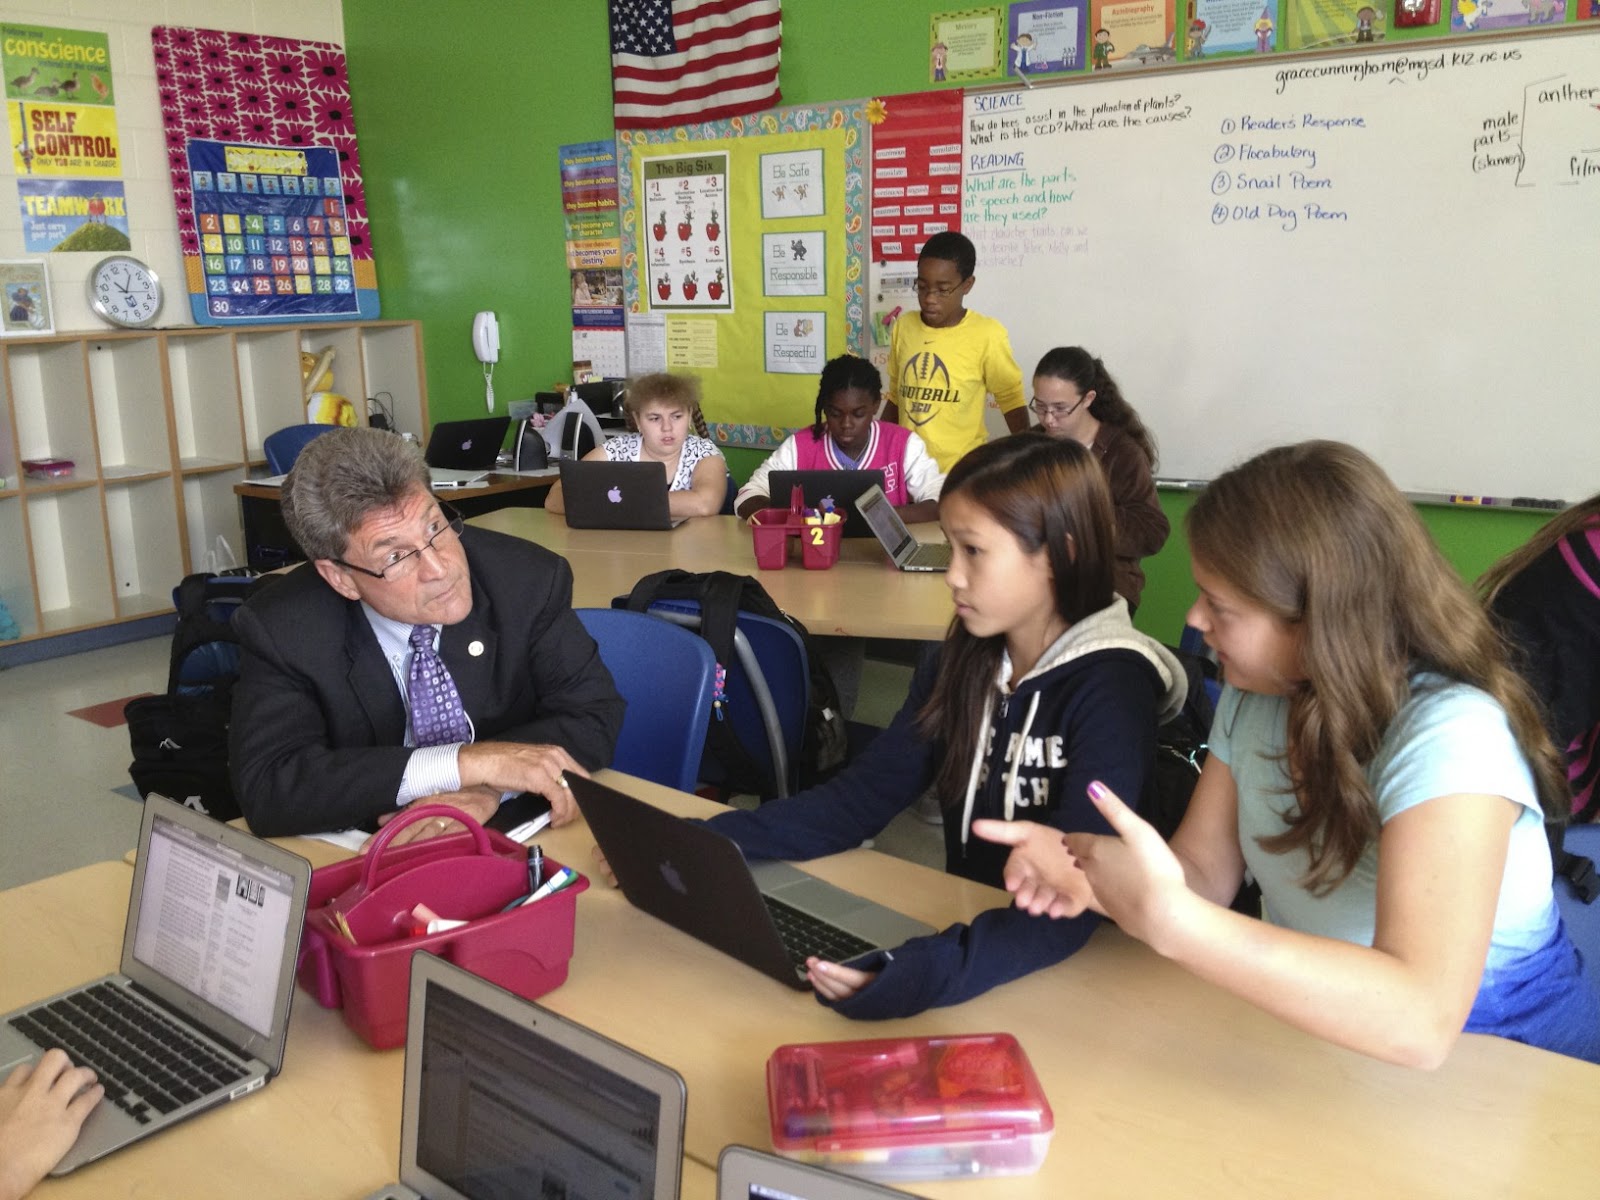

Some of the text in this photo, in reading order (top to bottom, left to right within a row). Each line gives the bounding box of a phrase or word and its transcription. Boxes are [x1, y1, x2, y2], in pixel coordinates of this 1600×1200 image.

[1032, 11, 1064, 21] Non-Fiction
[4, 37, 106, 64] conscience
[974, 94, 1024, 111] SCIENCE
[31, 109, 77, 133] SELF
[988, 120, 997, 130] do
[1001, 118, 1019, 129] bees
[1025, 108, 1052, 125] assist
[1059, 110, 1066, 119] in
[1073, 105, 1087, 118] the
[1134, 98, 1142, 111] of
[1303, 113, 1366, 130] Response
[1483, 110, 1518, 131] male
[970, 132, 994, 145] What
[1000, 132, 1009, 141] is
[1013, 127, 1029, 139] the
[1098, 119, 1119, 128] are
[1123, 115, 1142, 127] the
[1146, 106, 1192, 125] causes?
[34, 134, 117, 158] CONTROL
[1473, 129, 1510, 152] parts
[656, 159, 713, 175] The Big Six
[773, 162, 810, 179] Be Safe
[970, 152, 1025, 171] READING
[965, 175, 994, 193] What
[998, 178, 1016, 190] are
[1021, 171, 1036, 187] the
[1042, 166, 1077, 189] parts
[1237, 173, 1281, 190] Snail
[1289, 171, 1332, 190] Poem
[598, 198, 617, 207] habits.
[965, 189, 1074, 214] of speech and how
[206, 219, 215, 230] 2
[252, 219, 260, 230] 4
[273, 220, 280, 231] 5
[293, 220, 300, 232] 6
[313, 220, 320, 231] 7
[334, 221, 341, 232] 8
[602, 221, 614, 229] your
[964, 207, 1048, 227] are they used?
[1232, 206, 1259, 220] Old
[1267, 203, 1297, 232] Dog
[1304, 203, 1348, 221] Poem
[231, 239, 241, 250] 10
[251, 240, 260, 250] 11
[272, 240, 282, 250] 12
[292, 240, 303, 251] 13
[315, 240, 325, 251] 14
[575, 248, 617, 257] becomes your
[773, 244, 786, 258] Be
[209, 259, 221, 270] 16
[230, 259, 241, 270] 17
[253, 259, 264, 270] 18
[274, 260, 286, 271] 19
[294, 259, 308, 270] 20
[335, 261, 348, 272] 22
[211, 280, 227, 292] 23
[256, 279, 271, 291] 25
[277, 279, 292, 291] 26
[317, 280, 331, 291] 28
[336, 279, 349, 290] 29
[770, 267, 818, 286] Responsible
[213, 301, 229, 313] 30
[776, 322, 788, 336] Be
[773, 344, 817, 363] Respectful
[810, 527, 824, 545] 2
